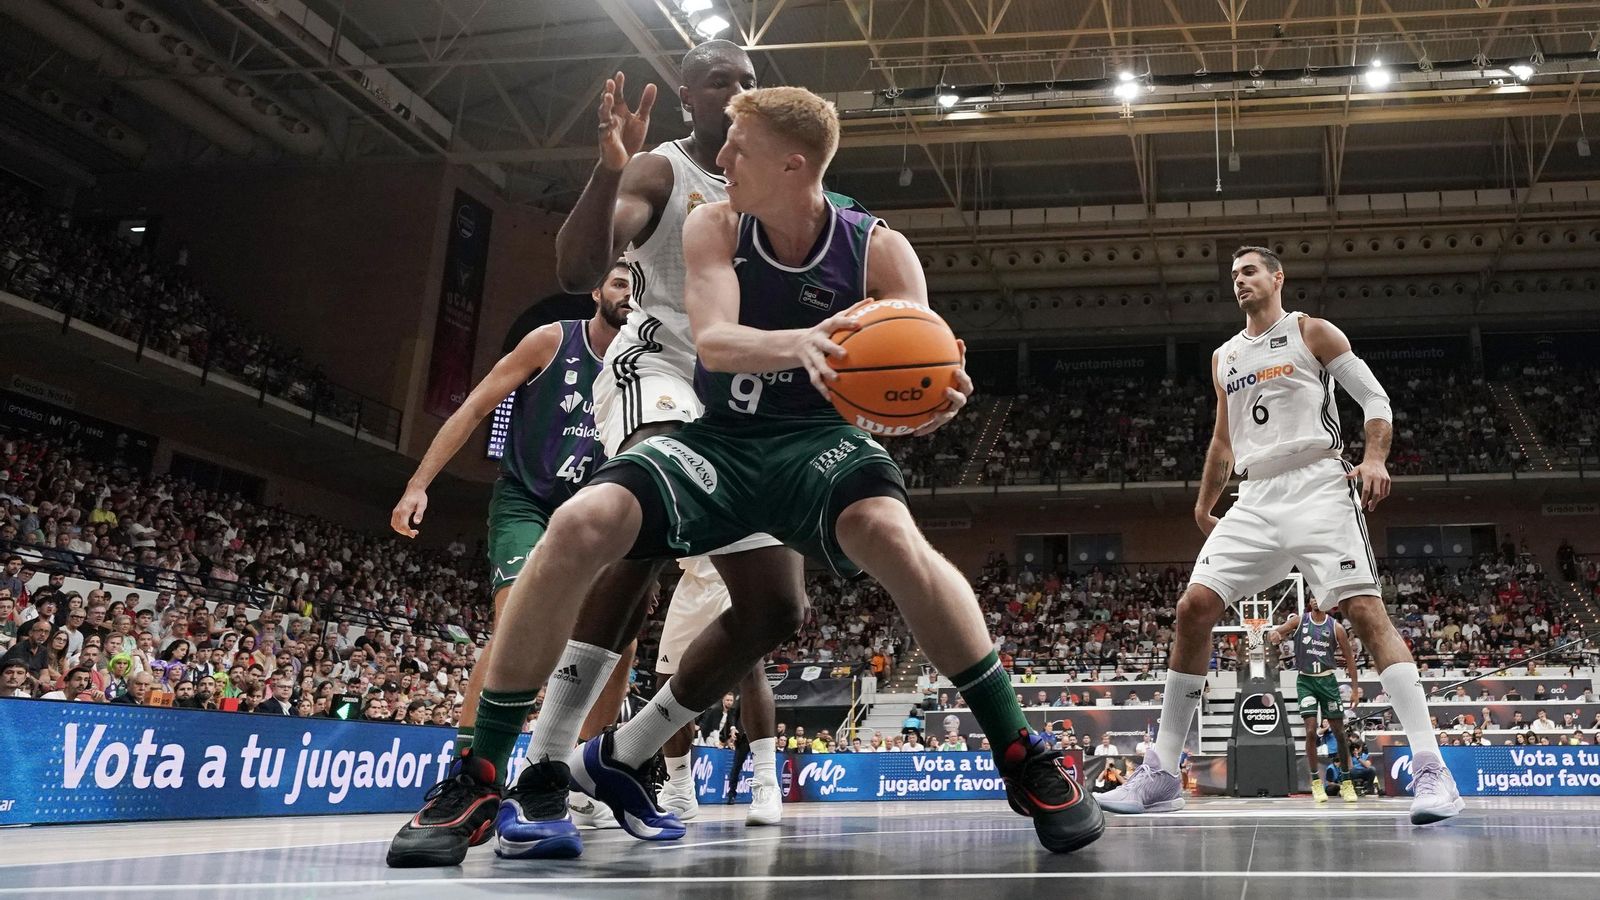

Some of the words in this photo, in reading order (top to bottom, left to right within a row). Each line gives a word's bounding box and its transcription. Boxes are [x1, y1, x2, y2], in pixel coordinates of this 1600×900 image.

[1358, 346, 1446, 361] yuntamiento
[1055, 358, 1145, 371] Ayuntamiento
[1226, 364, 1294, 396] AUTOHERO
[728, 373, 763, 415] 9
[885, 387, 924, 402] acb
[8, 404, 43, 421] endesa
[1252, 394, 1269, 425] 6
[562, 422, 601, 441] málag
[556, 455, 592, 484] 45
[1312, 661, 1321, 673] 11
[63, 722, 184, 789] Vota
[199, 745, 227, 788] a
[241, 734, 286, 787] tu
[284, 731, 431, 805] jugador
[912, 755, 956, 772] Vota
[960, 758, 971, 771] a
[975, 755, 996, 771] tu
[1510, 750, 1558, 767] Vota
[1562, 754, 1575, 767] a
[1578, 750, 1600, 767] tu
[876, 775, 950, 797] jugador
[1476, 770, 1553, 792] jugador
